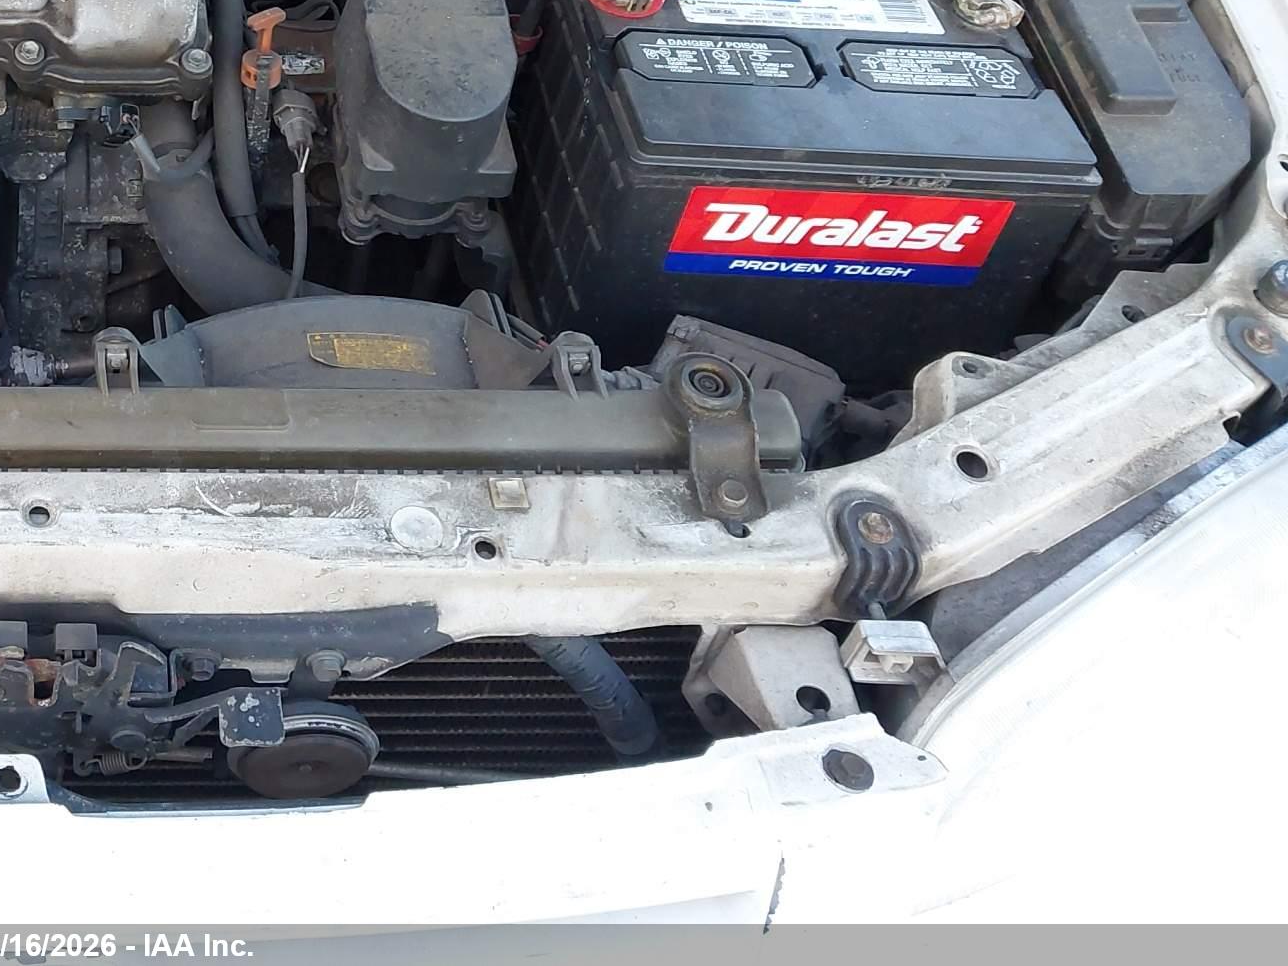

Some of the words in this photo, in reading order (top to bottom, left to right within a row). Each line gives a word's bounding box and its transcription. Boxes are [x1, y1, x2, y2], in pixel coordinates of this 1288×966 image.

[666, 38, 716, 48] DANGER
[724, 41, 769, 50] POISON
[702, 202, 984, 253] Duralast
[728, 259, 828, 275] PROVEN
[833, 264, 915, 278] TOUGH
